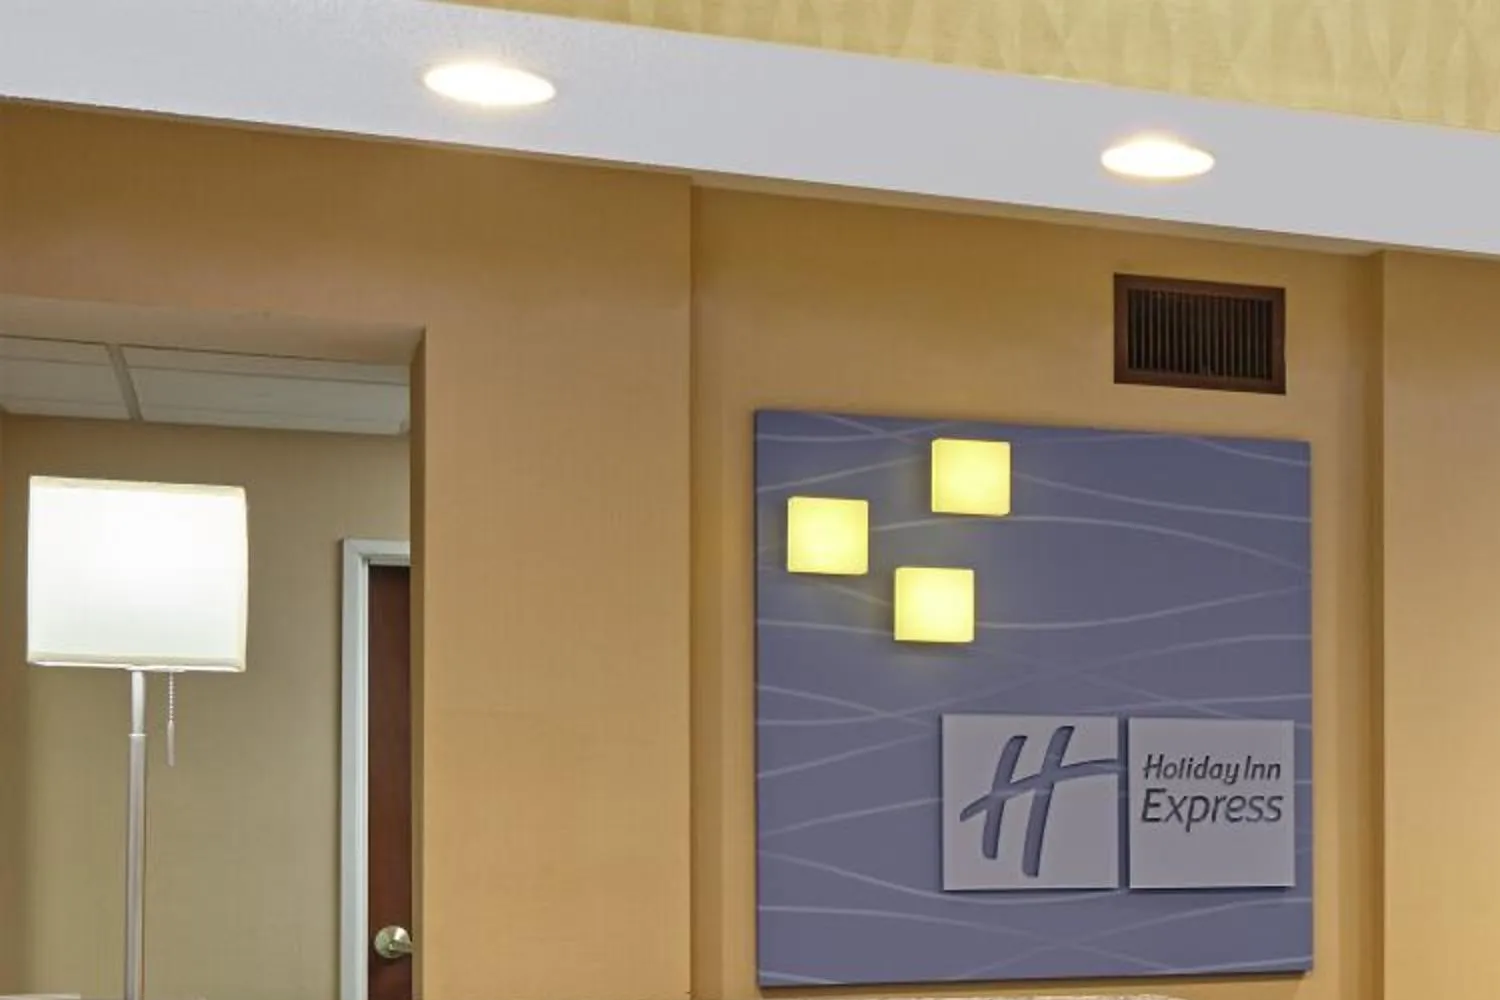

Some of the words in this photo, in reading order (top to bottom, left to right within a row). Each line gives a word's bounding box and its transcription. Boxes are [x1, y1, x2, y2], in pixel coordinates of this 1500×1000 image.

[1143, 753, 1241, 785] Holiday
[1243, 755, 1281, 780] Inn
[959, 725, 1119, 878] H
[1140, 788, 1284, 833] Express
